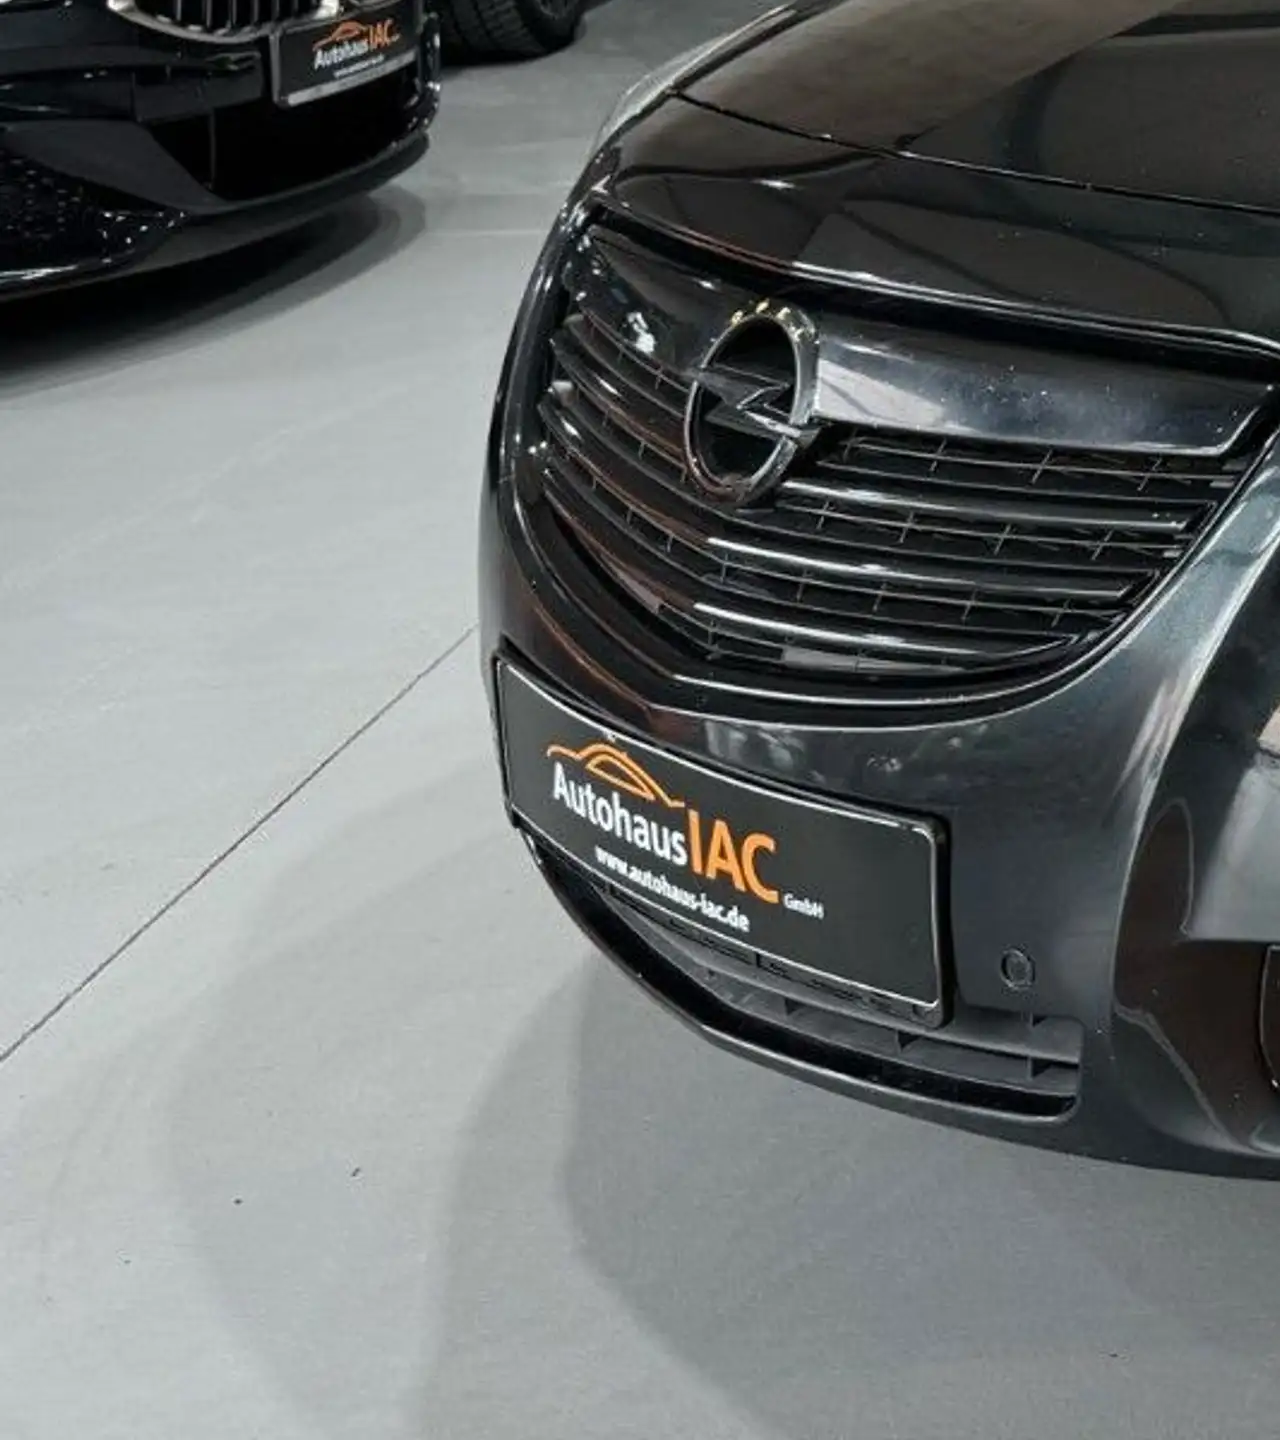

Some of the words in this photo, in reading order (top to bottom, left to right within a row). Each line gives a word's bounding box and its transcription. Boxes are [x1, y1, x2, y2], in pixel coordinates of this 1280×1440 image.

[314, 39, 369, 70] Autohaus
[368, 18, 393, 52] IAC
[552, 761, 689, 866] Autohaus
[686, 808, 780, 905] IAC
[782, 892, 825, 920] GmbH
[594, 844, 751, 933] www.autohaus-iac.de
